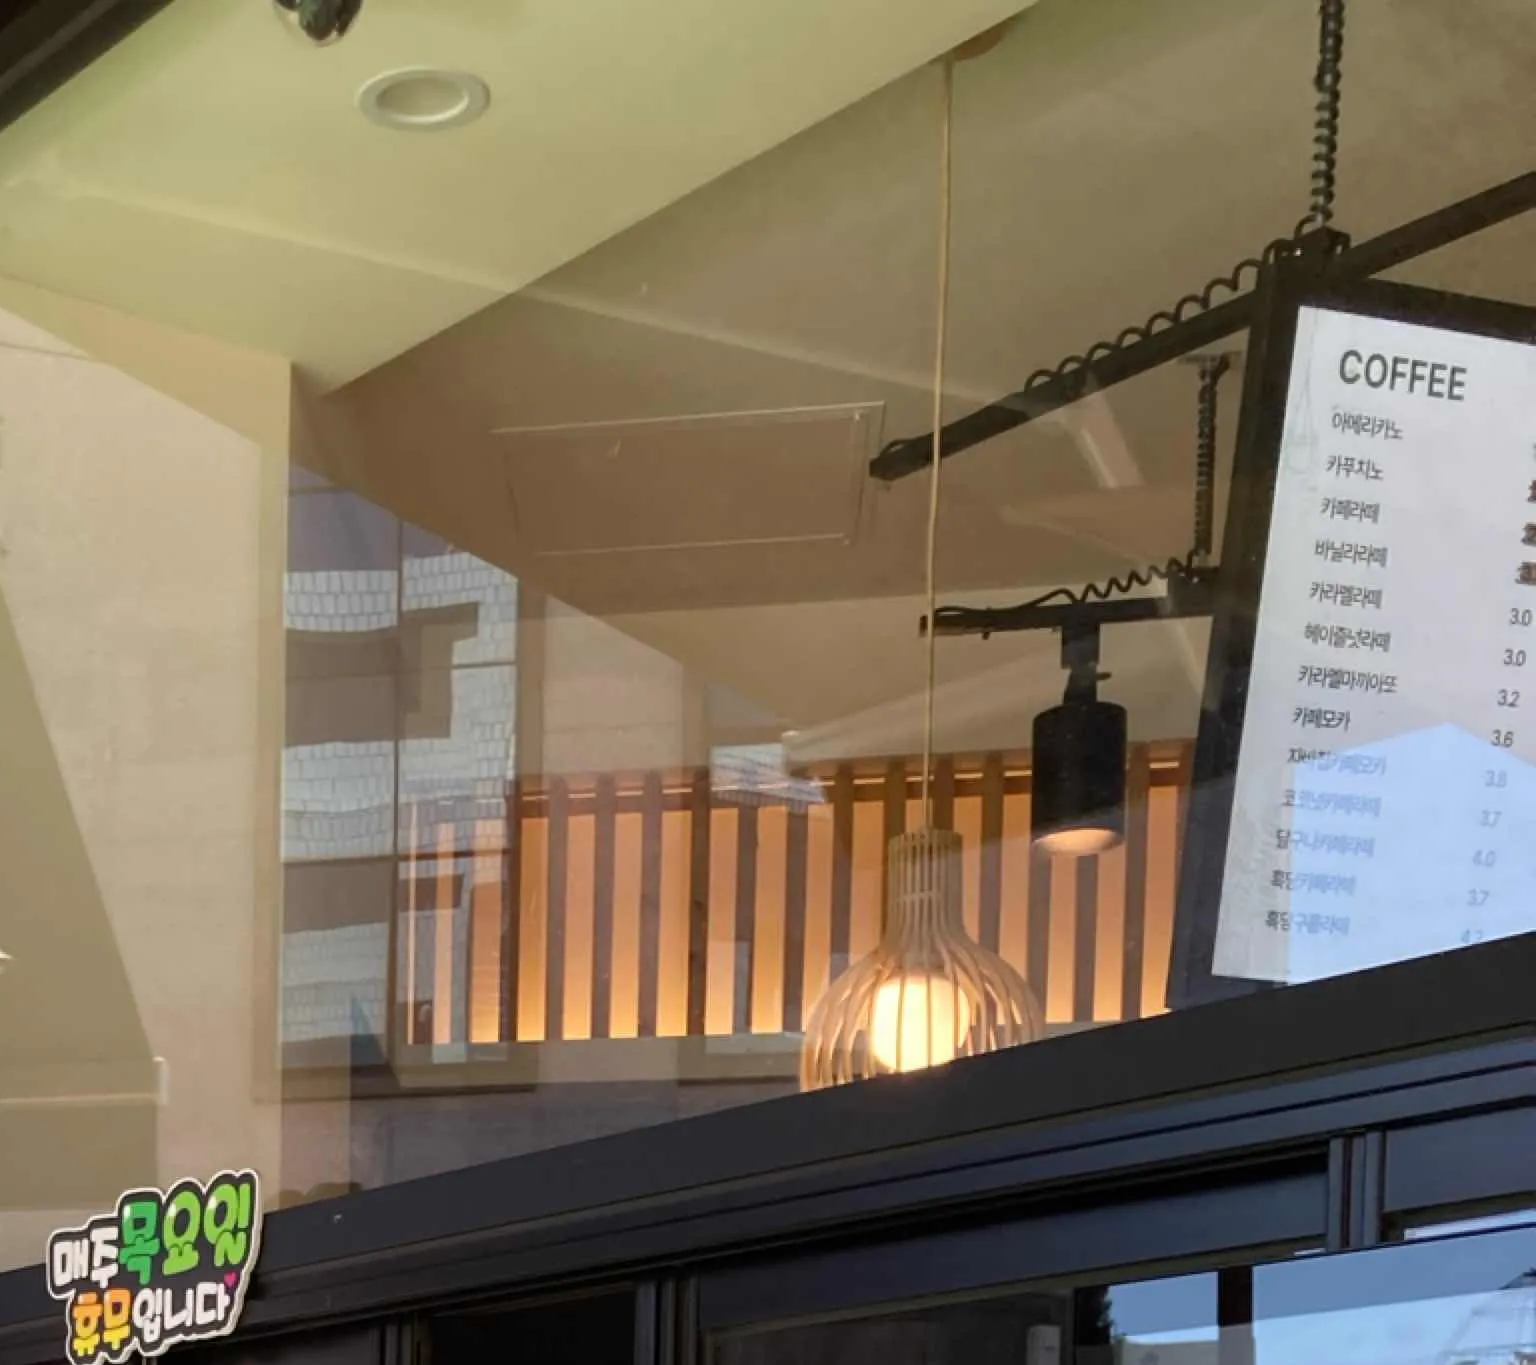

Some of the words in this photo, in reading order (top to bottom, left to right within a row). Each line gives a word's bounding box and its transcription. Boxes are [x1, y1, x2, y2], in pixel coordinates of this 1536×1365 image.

[1339, 350, 1467, 401] COFFEE
[1332, 412, 1403, 440] 아메리카노
[1326, 455, 1384, 481] 카푸치노
[1320, 498, 1380, 523] 카페라떼
[1314, 540, 1388, 567] 바닐라라떼
[1310, 581, 1382, 609] 카라멜라떼
[1304, 623, 1391, 652] 헤이즐넛라떼
[1293, 707, 1350, 731] 카페모카
[73, 1282, 231, 1357] 휴무입니다
